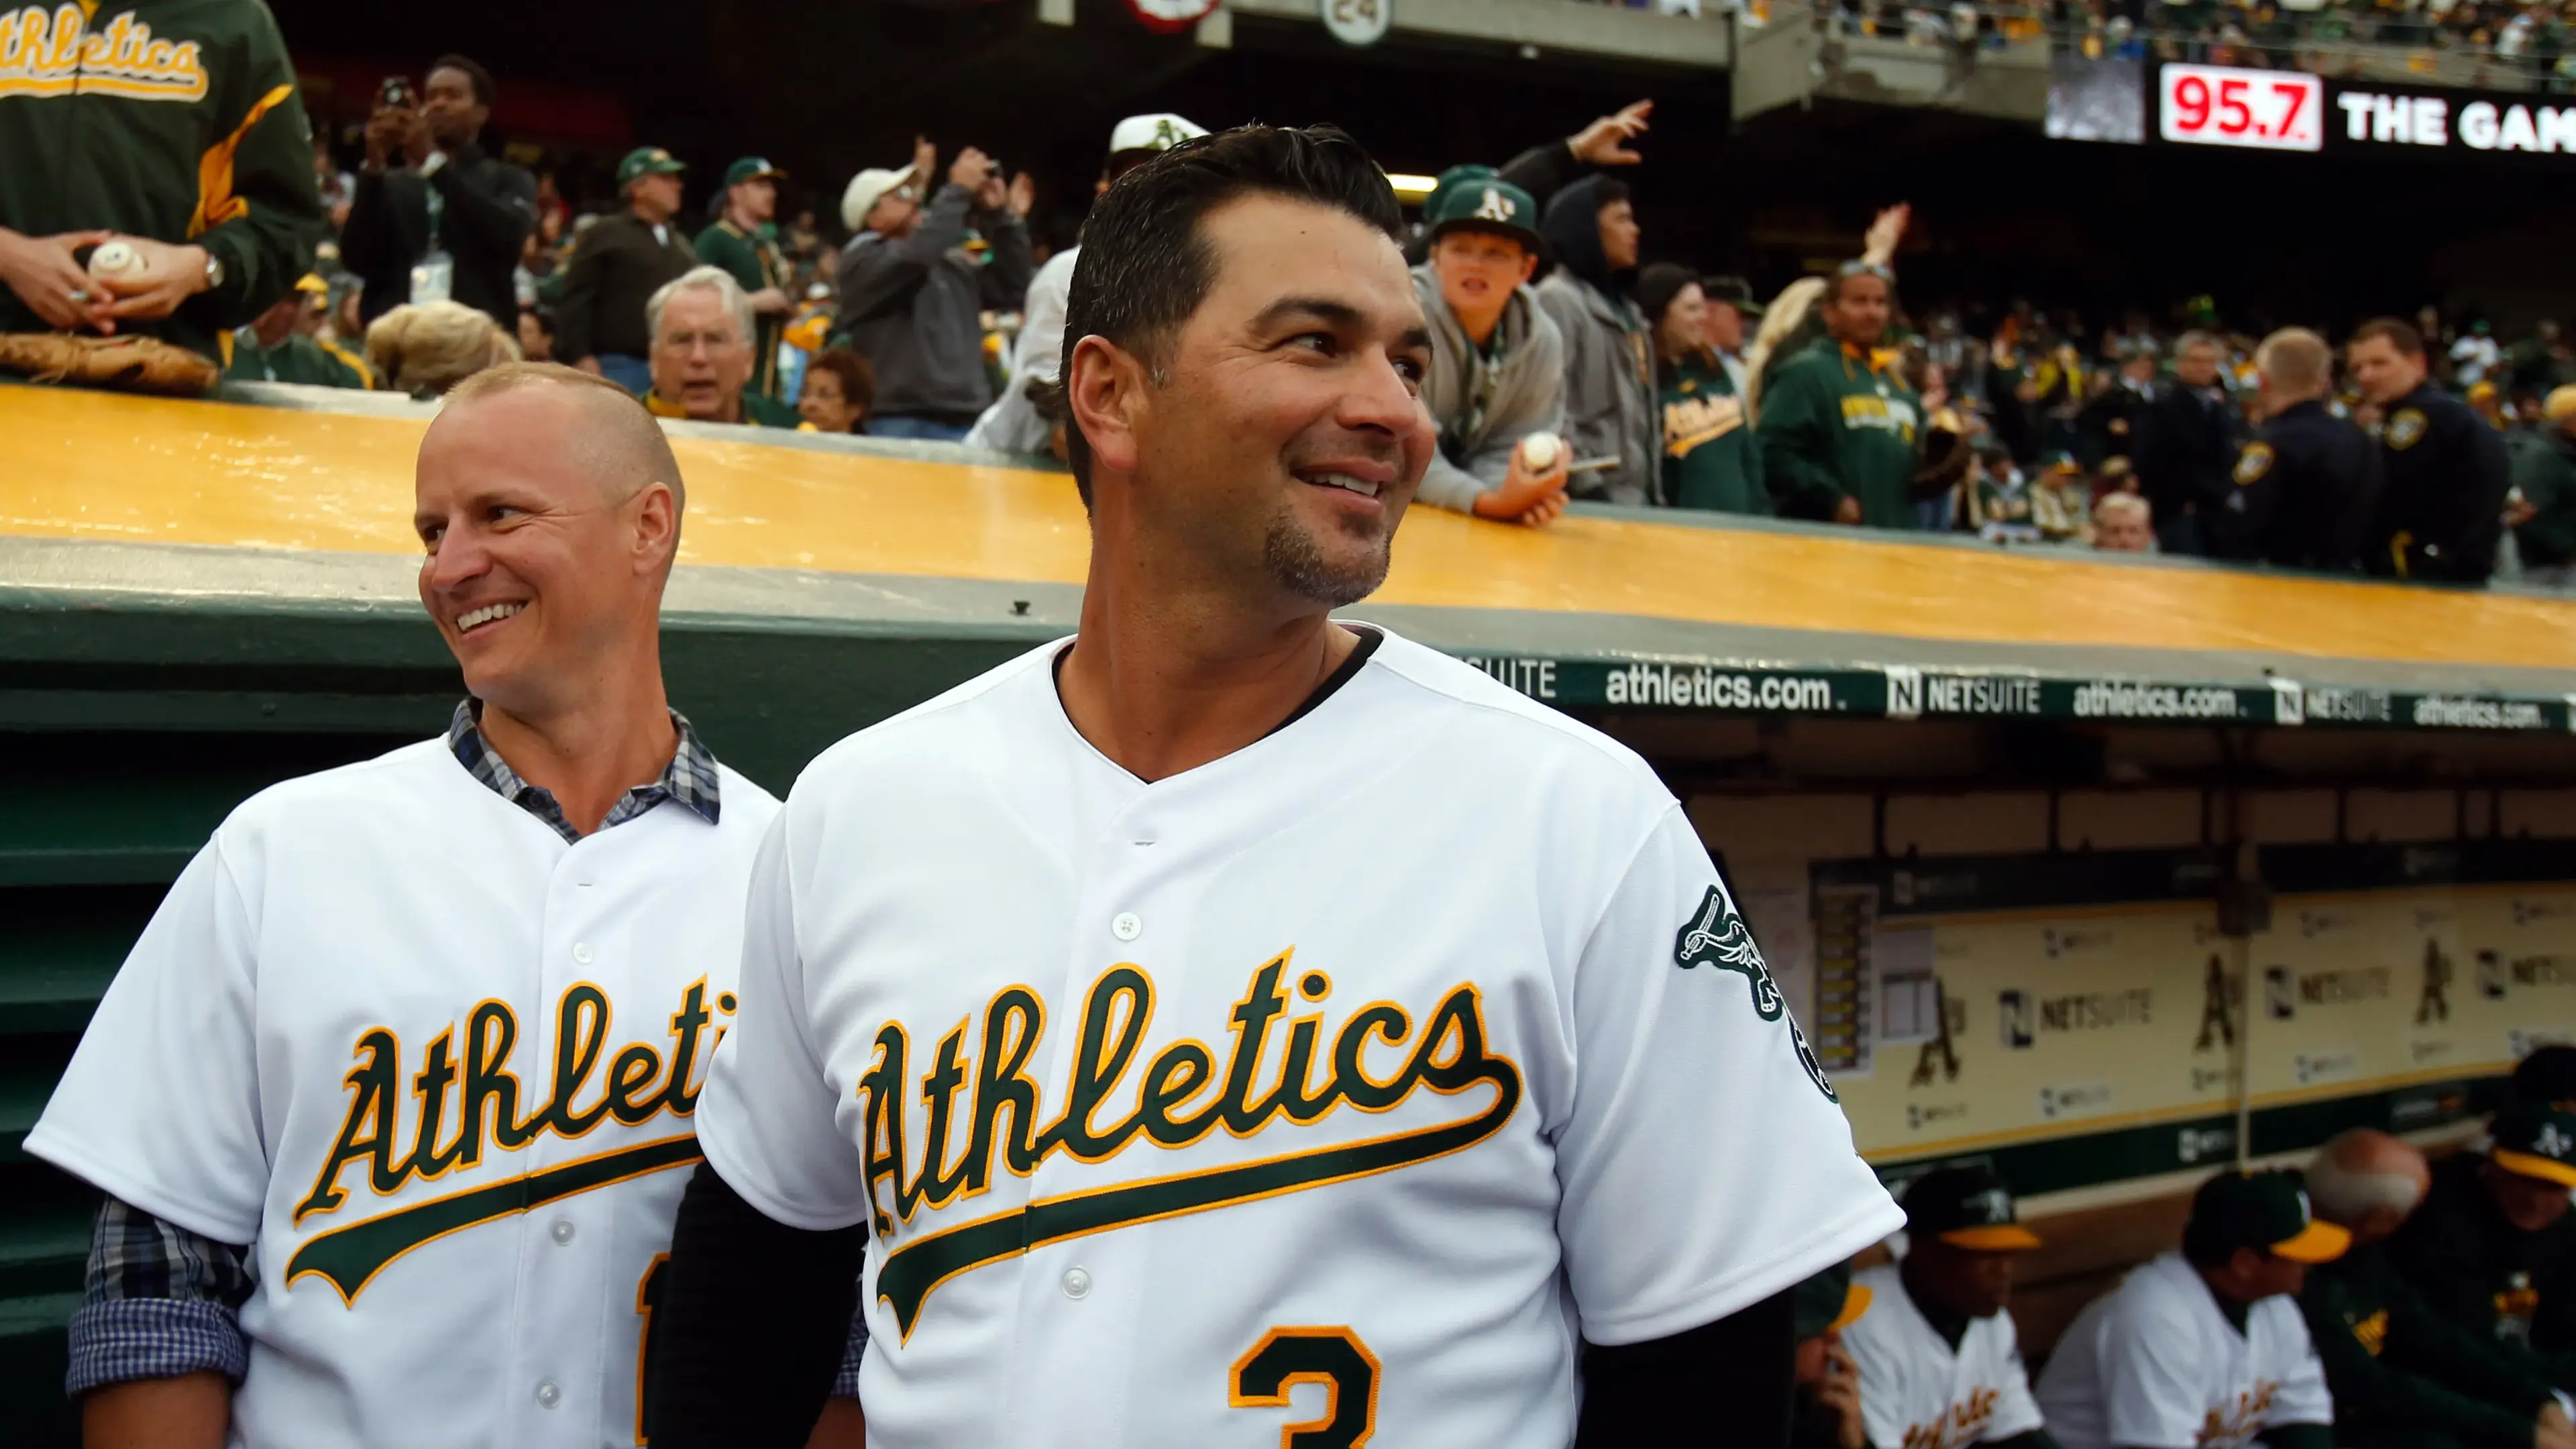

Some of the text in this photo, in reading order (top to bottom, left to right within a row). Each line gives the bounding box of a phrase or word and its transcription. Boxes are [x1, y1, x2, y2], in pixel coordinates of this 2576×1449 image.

[0, 3, 201, 75] thletics
[2174, 75, 2308, 138] 95.7
[2337, 91, 2449, 146] THE
[1453, 656, 1556, 698] UITE
[1605, 663, 1831, 710] athletics.com
[1928, 677, 2041, 714] NETSUITE
[857, 945, 1521, 1245] Athletics
